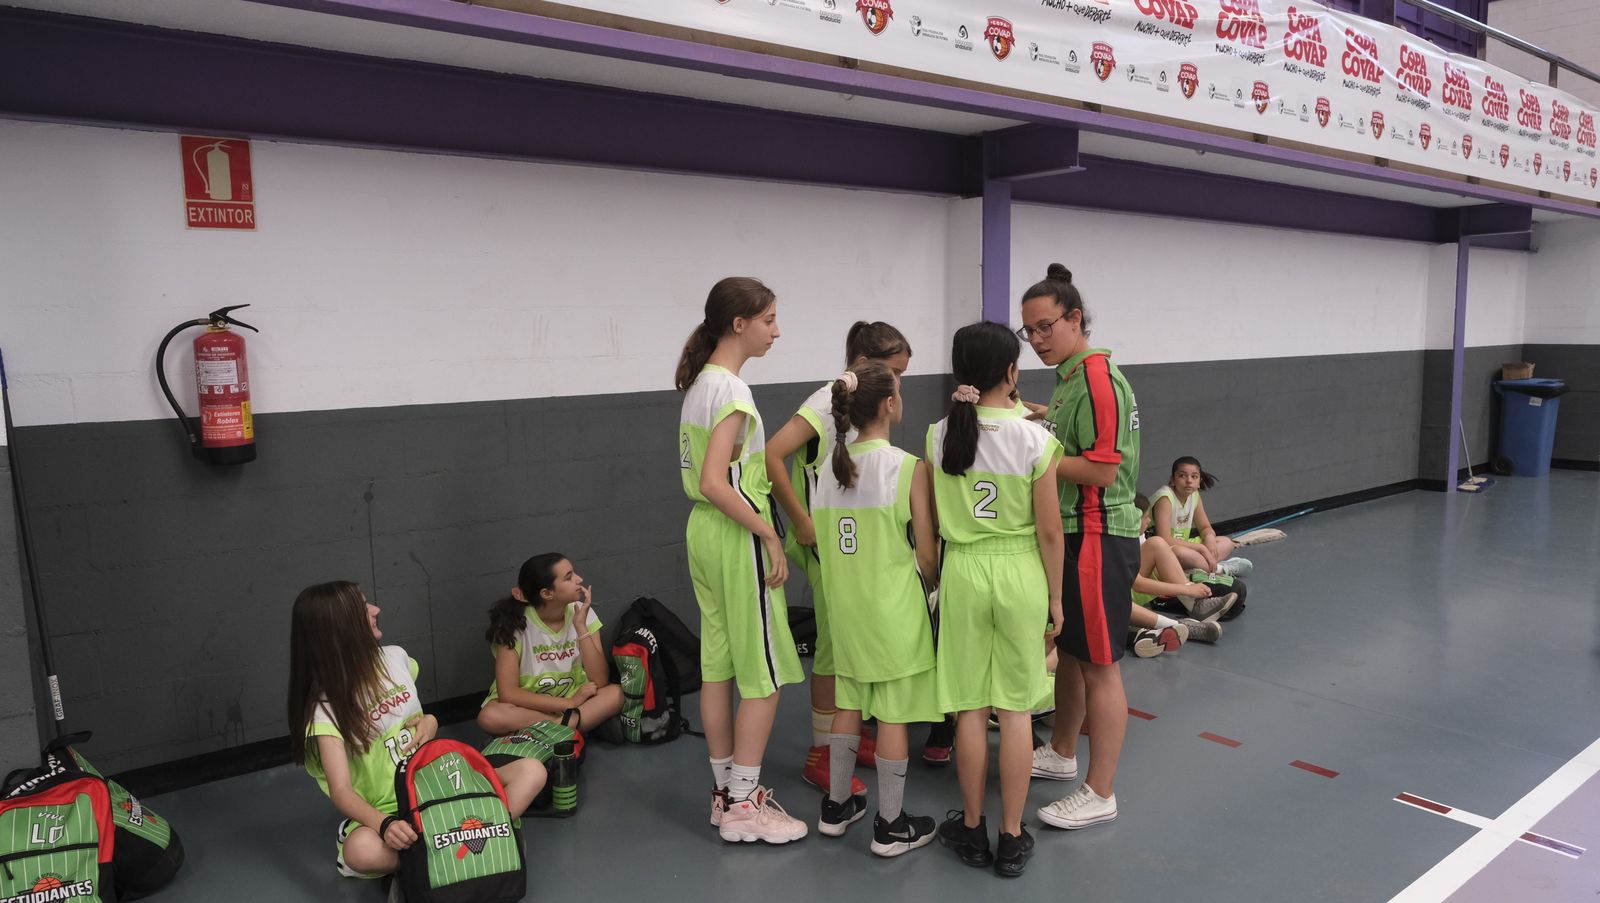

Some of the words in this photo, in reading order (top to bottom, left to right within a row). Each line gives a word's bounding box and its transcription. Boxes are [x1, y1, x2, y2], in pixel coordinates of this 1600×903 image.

[988, 27, 1012, 39] COVAP
[1216, 11, 1267, 50] COVAP
[1287, 6, 1322, 44] COPA
[1283, 32, 1328, 68] COVAP
[1345, 28, 1378, 61] COPA
[1341, 51, 1385, 84] COVAP
[1400, 44, 1428, 77] COPA
[1396, 67, 1432, 98] COVAP
[1444, 62, 1470, 91] COPA
[1485, 75, 1508, 103] COPA
[1442, 82, 1472, 111] COVAP
[1482, 95, 1510, 122] COVAP
[1519, 88, 1541, 114] COPA
[1517, 107, 1543, 132] COVAP
[1552, 99, 1570, 124] COPA
[1549, 117, 1572, 141] COVAP
[1576, 127, 1597, 149] COVAP
[188, 206, 254, 224] EXTINTOR
[973, 480, 998, 519] 2
[838, 516, 858, 554] 8
[369, 691, 411, 721] COVAP
[447, 769, 462, 791] 7
[433, 822, 510, 850] ESTUDIANTES
